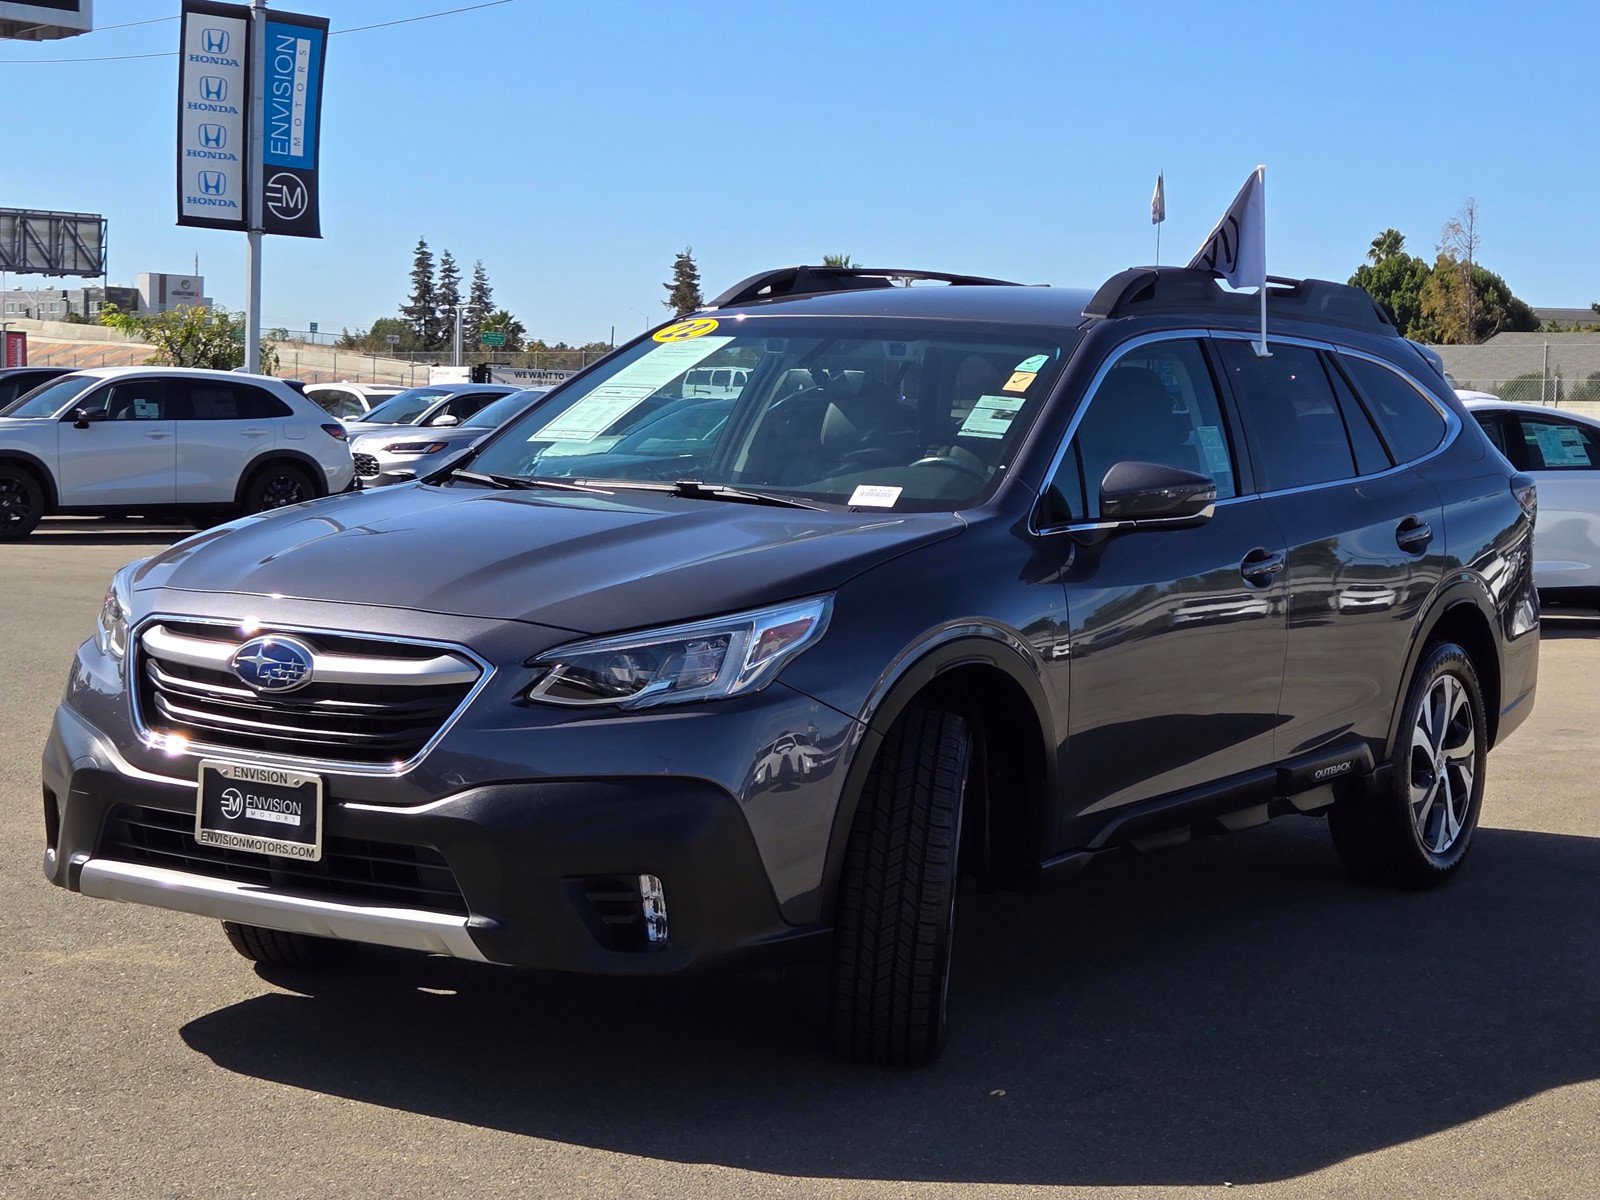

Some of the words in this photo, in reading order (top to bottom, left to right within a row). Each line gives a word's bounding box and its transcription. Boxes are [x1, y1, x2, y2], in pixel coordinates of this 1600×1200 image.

[188, 54, 240, 68] HONDA
[270, 34, 296, 156] ENVISION
[293, 49, 307, 147] MOTORS
[187, 102, 239, 115] HONDA
[186, 149, 238, 162] HONDA
[186, 196, 238, 208] HONDA
[514, 371, 527, 379] WE
[528, 371, 553, 380] WANT
[233, 766, 288, 785] ENVISION
[1314, 761, 1352, 779] OUTBACK
[245, 794, 302, 815] ENVISION
[249, 811, 297, 824] MOTORS
[200, 831, 316, 859] ENVISIONMOTORS.COM
